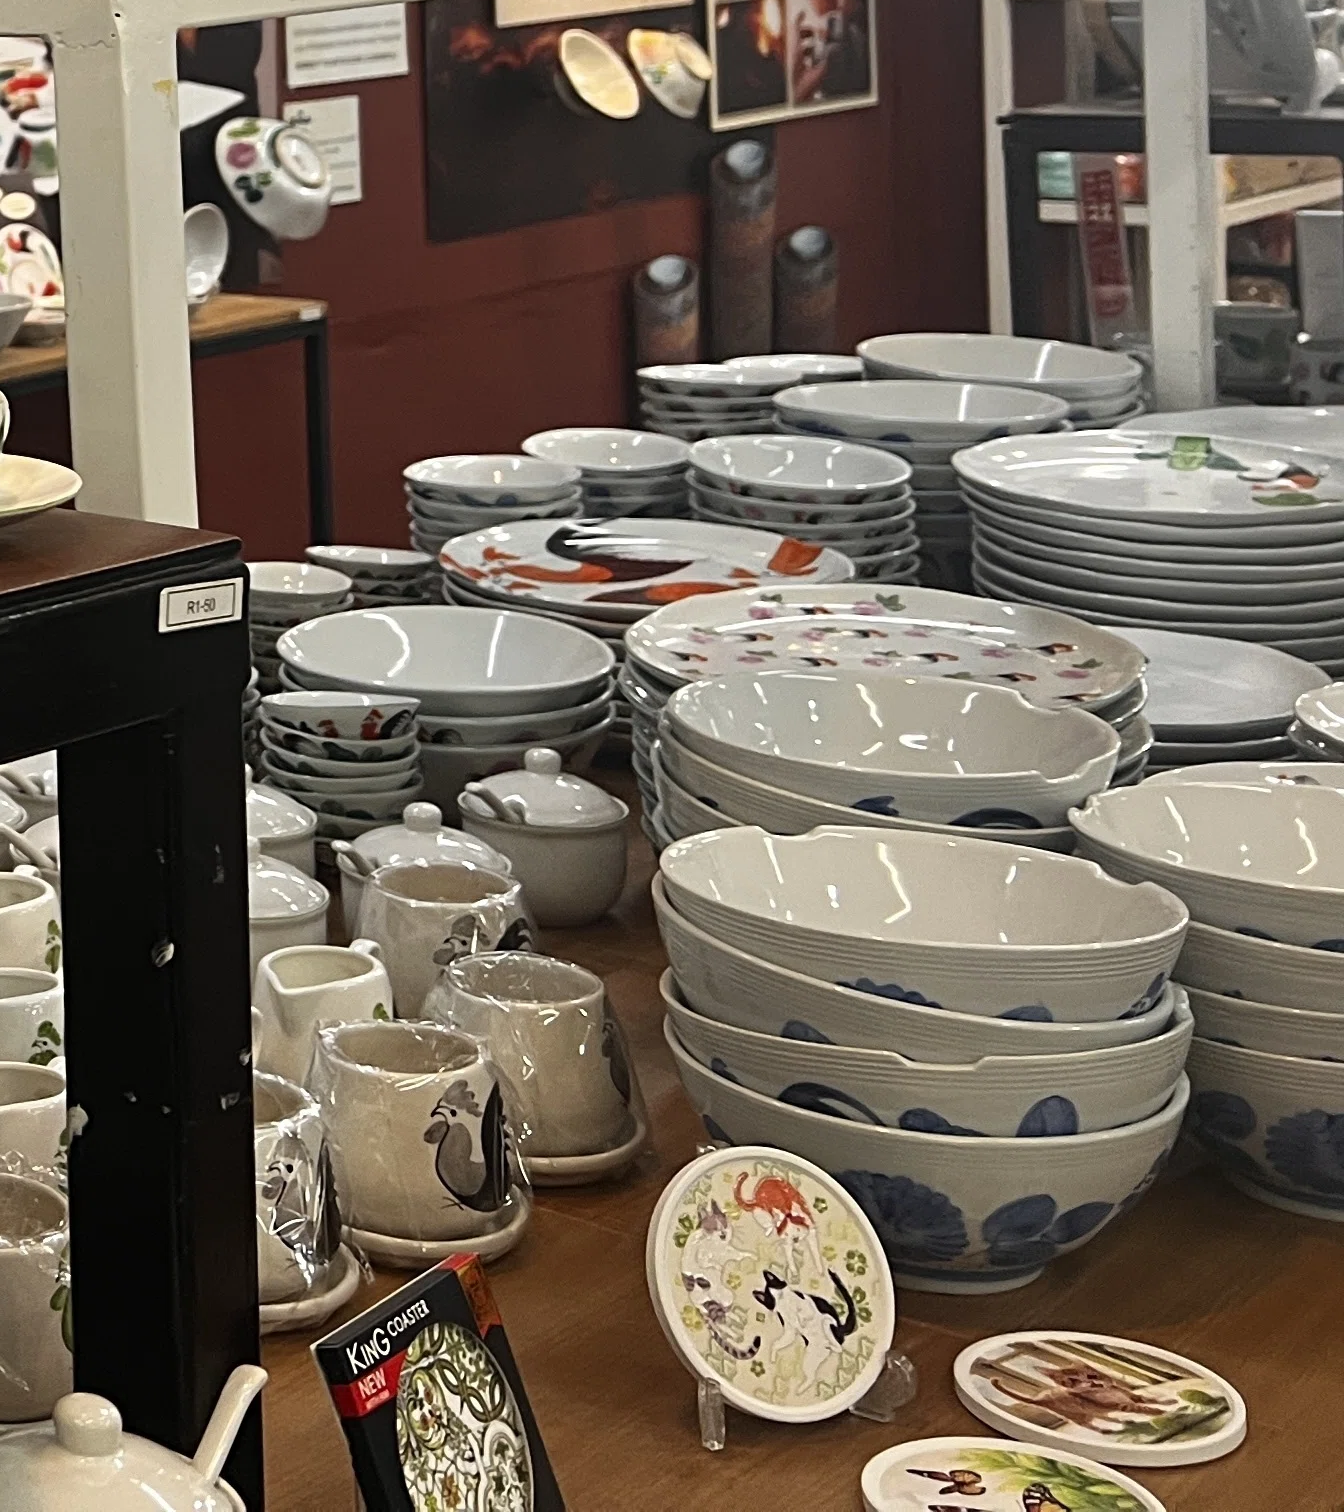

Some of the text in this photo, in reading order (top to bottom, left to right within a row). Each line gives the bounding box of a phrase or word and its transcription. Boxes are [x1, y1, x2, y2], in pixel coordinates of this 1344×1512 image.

[346, 1299, 430, 1375] KING COASTER
[357, 1367, 387, 1400] NEW
